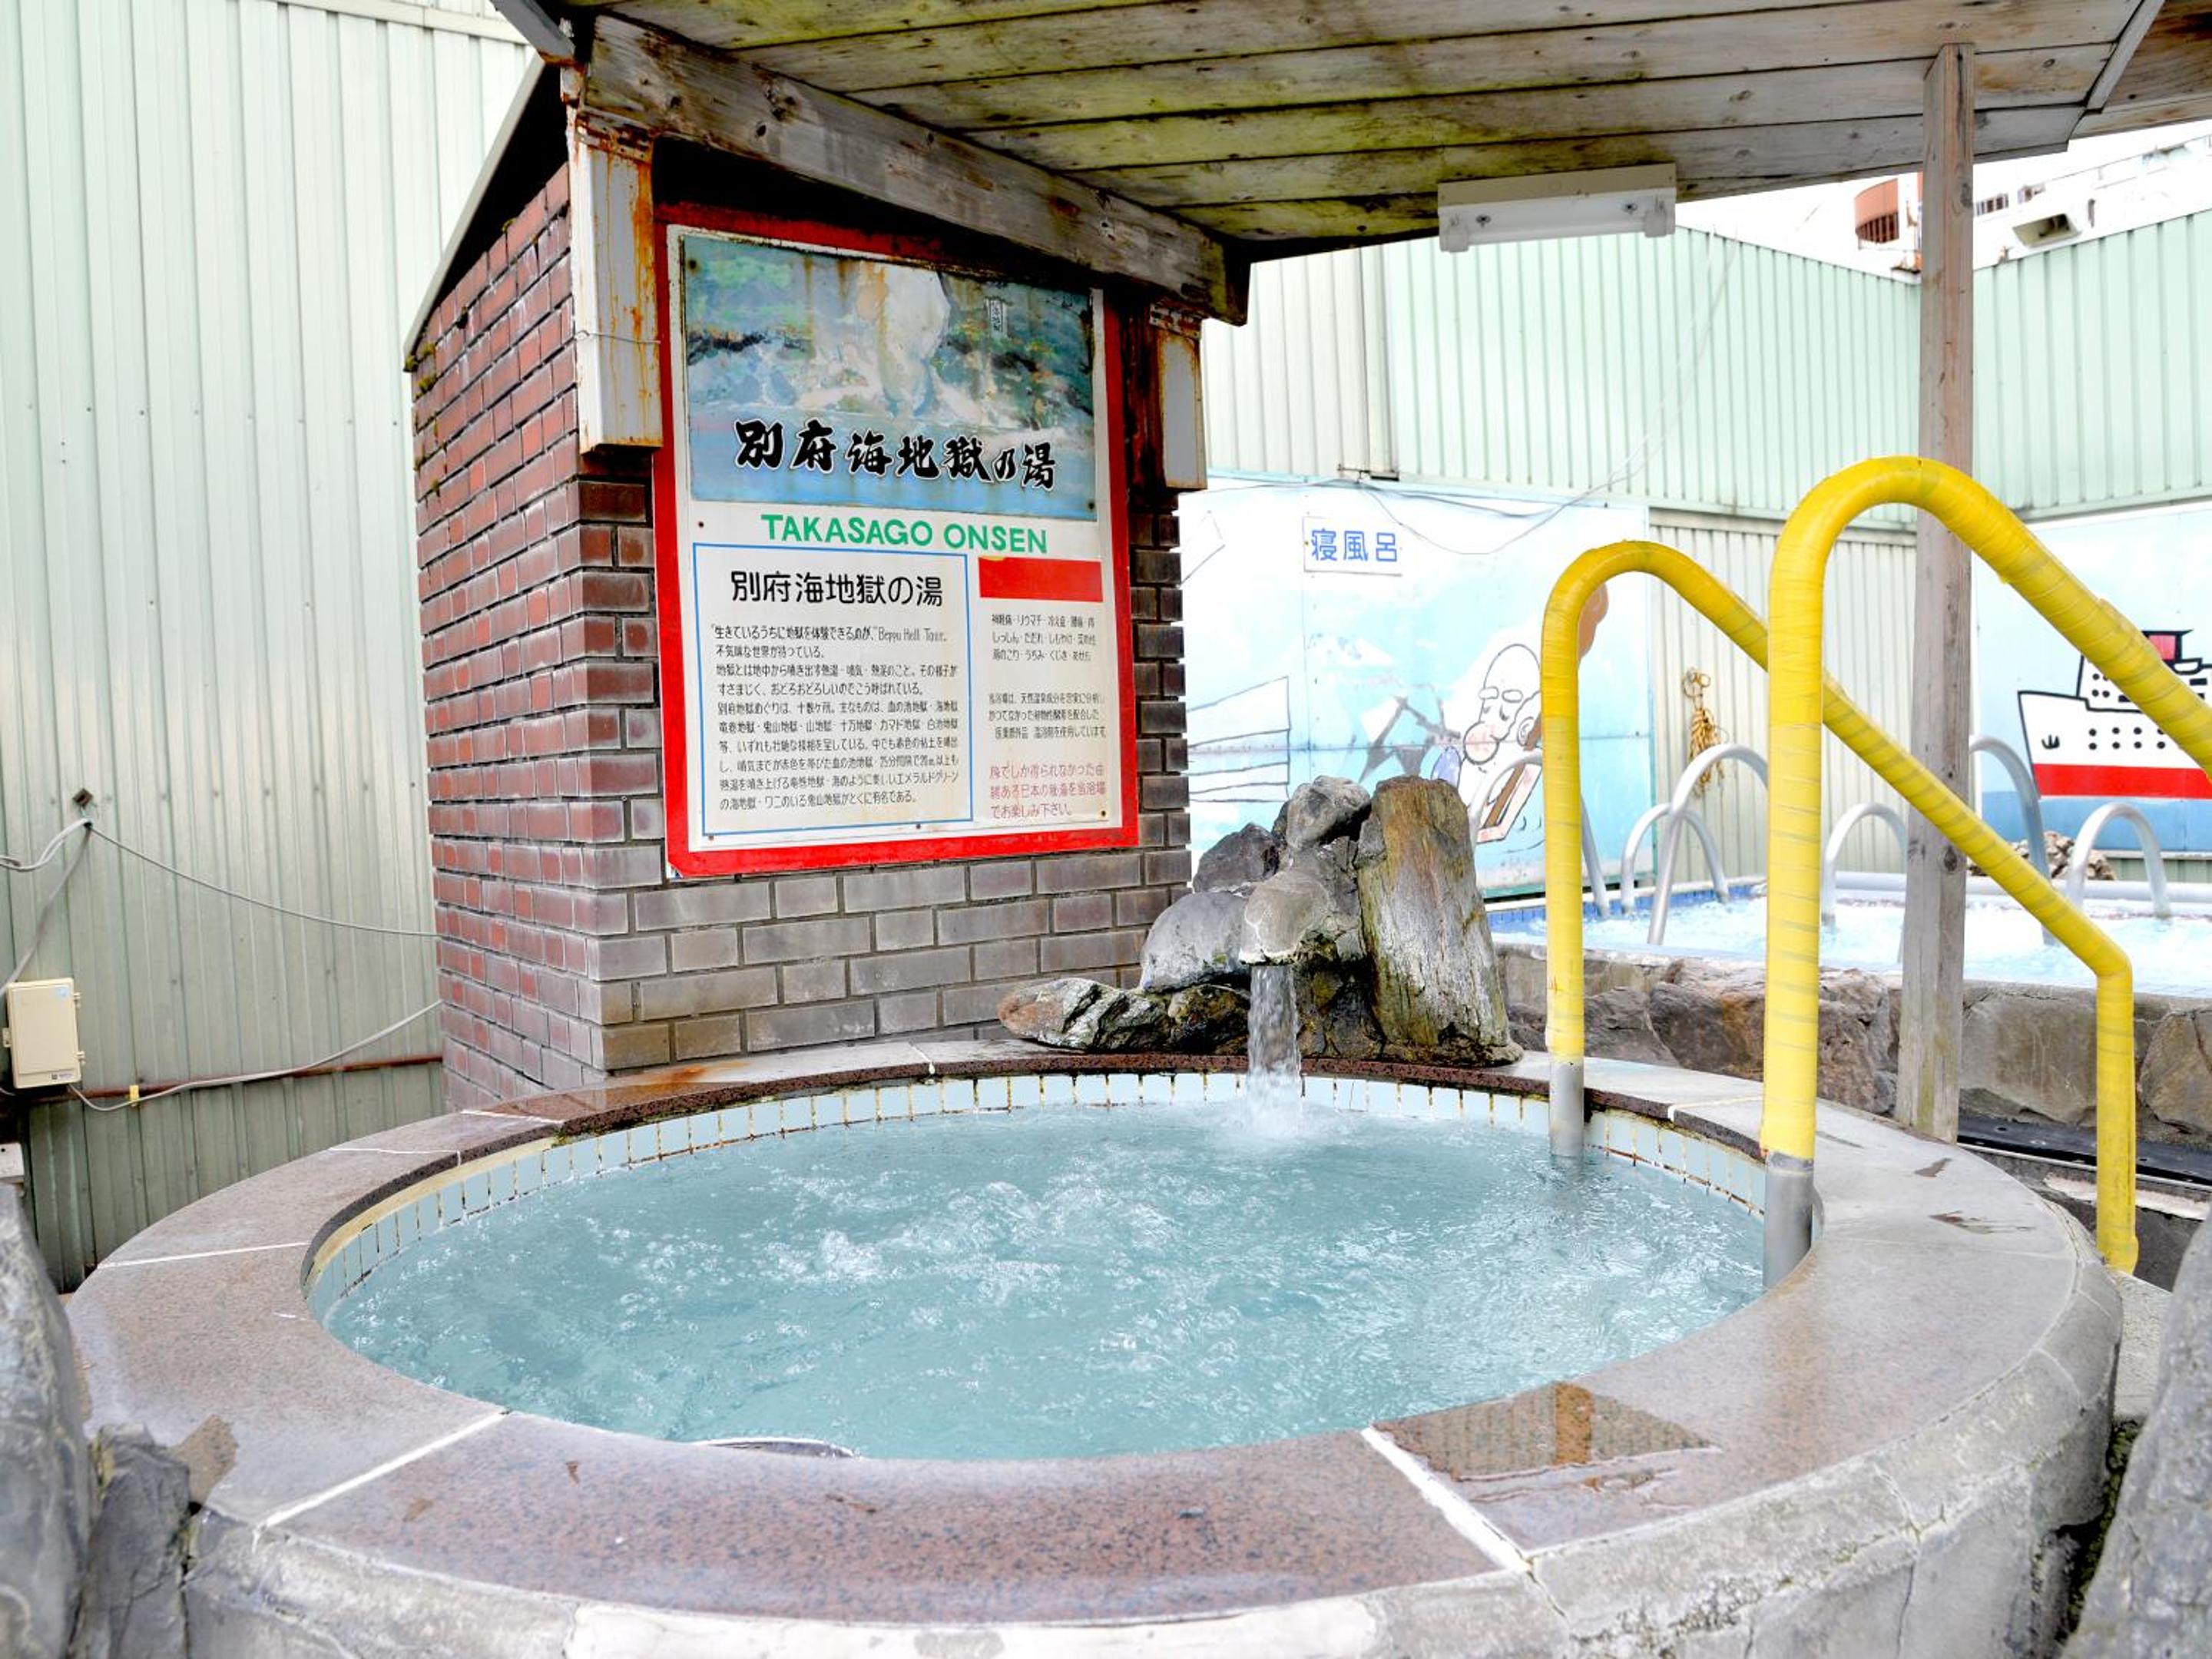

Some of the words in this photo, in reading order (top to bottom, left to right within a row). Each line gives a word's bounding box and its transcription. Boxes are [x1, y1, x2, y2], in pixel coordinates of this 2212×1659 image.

[734, 417, 1058, 491] 別府海地獄の湯
[761, 514, 932, 547] TAKASAGO
[944, 522, 1048, 554] ONSEN
[1310, 528, 1398, 562] 寝風呂
[730, 570, 943, 607] 別府海地獄の湯
